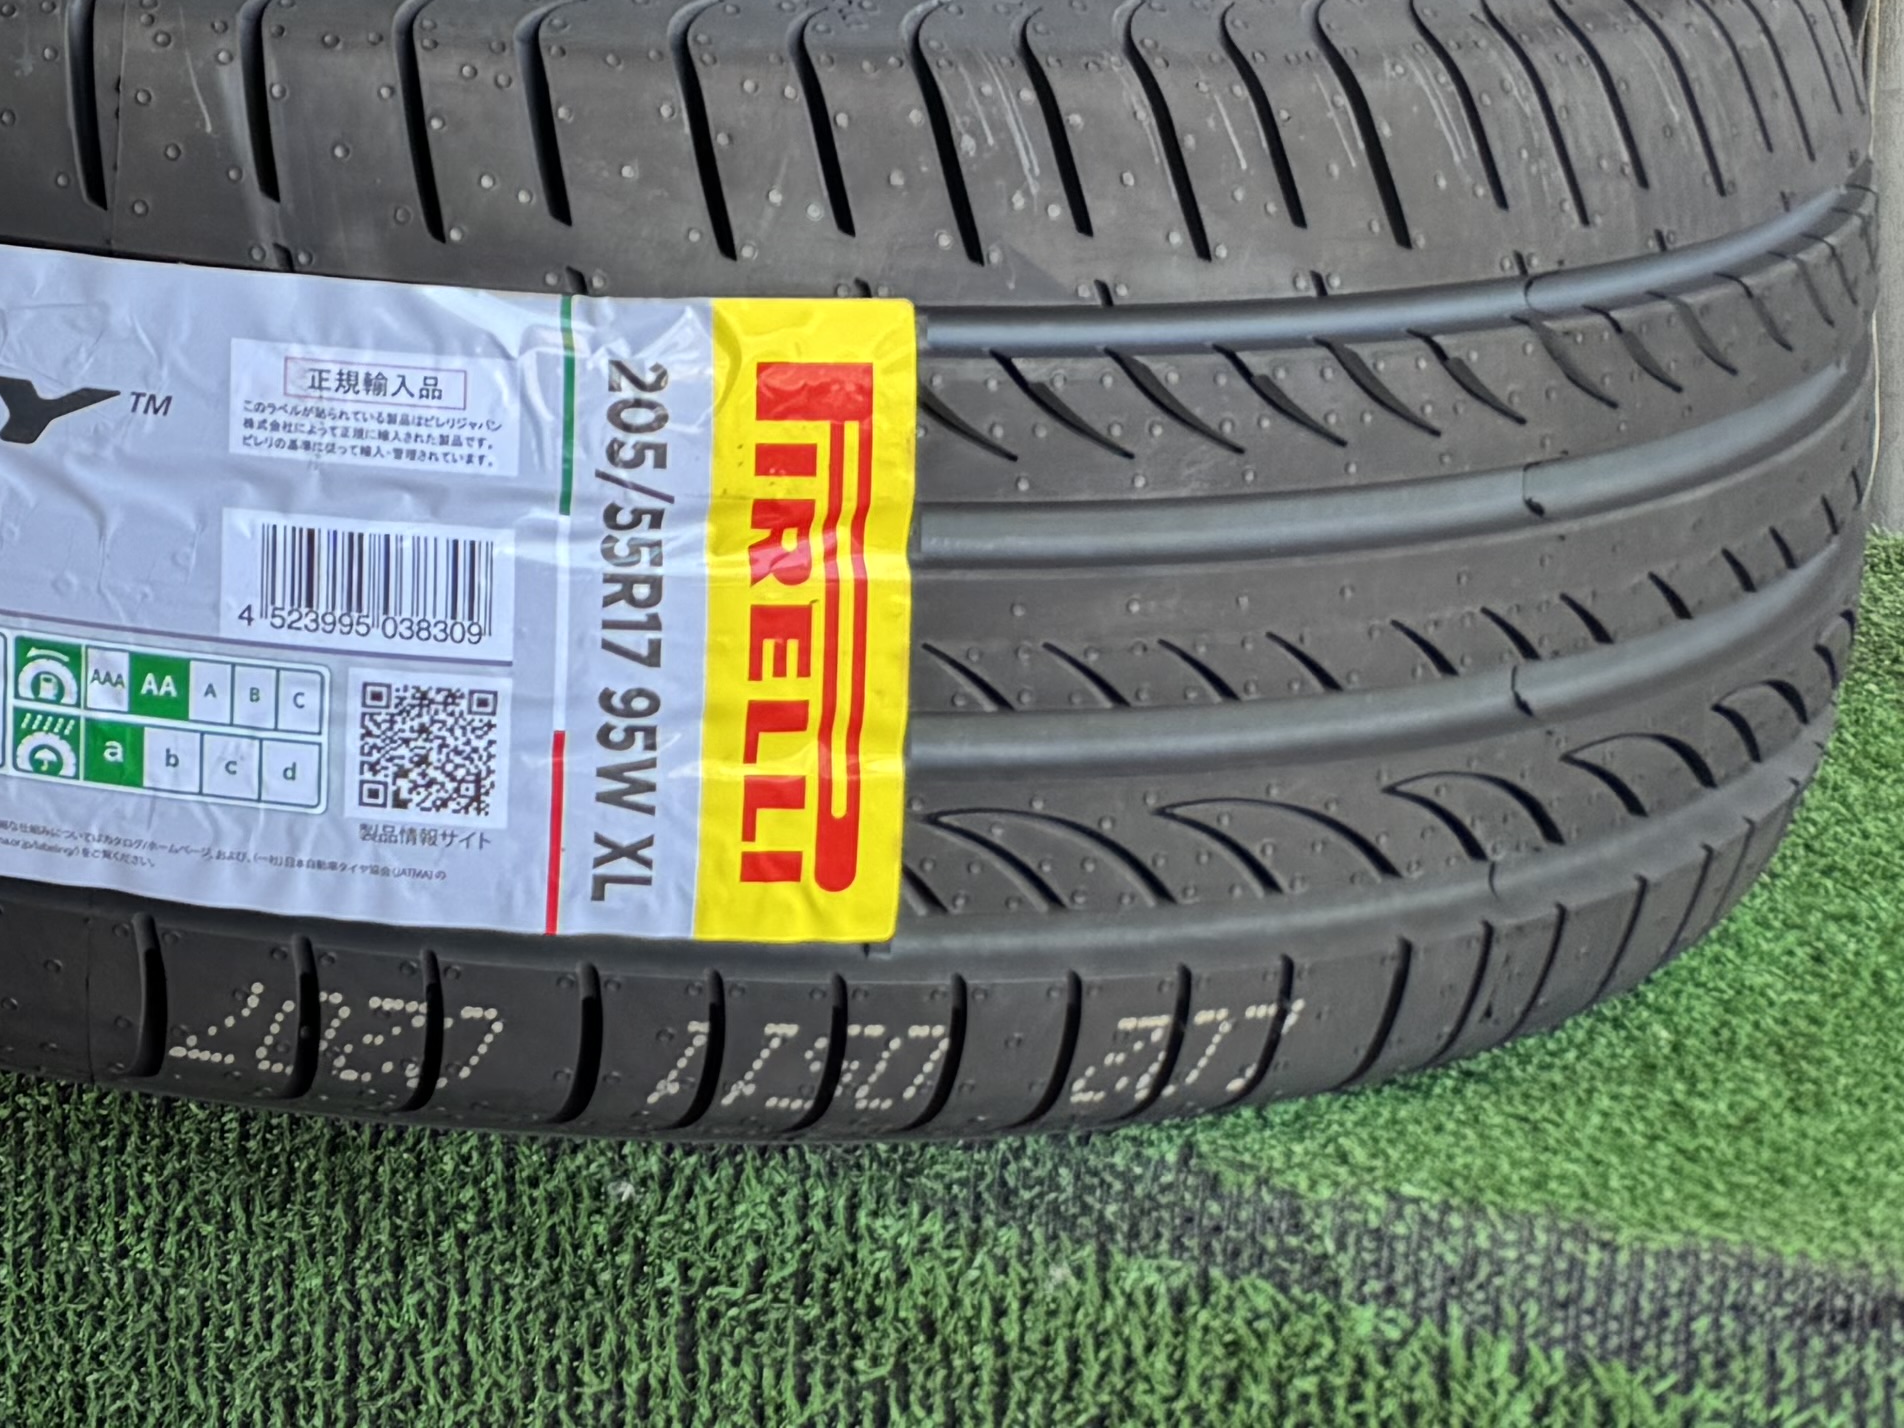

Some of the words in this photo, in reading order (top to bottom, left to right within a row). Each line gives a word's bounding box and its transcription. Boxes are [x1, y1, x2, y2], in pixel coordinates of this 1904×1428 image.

[307, 366, 444, 402] 正規輸入品
[595, 358, 675, 669] 205/55R17
[237, 605, 255, 627] 4
[270, 607, 371, 637] 523995
[382, 617, 482, 645] 038309
[739, 361, 873, 893] PIRELLI
[91, 667, 125, 690] AAA
[141, 673, 178, 698] AA
[204, 684, 217, 699] A
[249, 687, 260, 704] B
[293, 693, 305, 708] C
[103, 741, 124, 763] a
[164, 749, 179, 769] b
[224, 759, 238, 775] c
[283, 760, 296, 781] d
[592, 686, 662, 815] 95W
[358, 823, 492, 850] 製品情報サイト
[590, 833, 654, 902] XL
